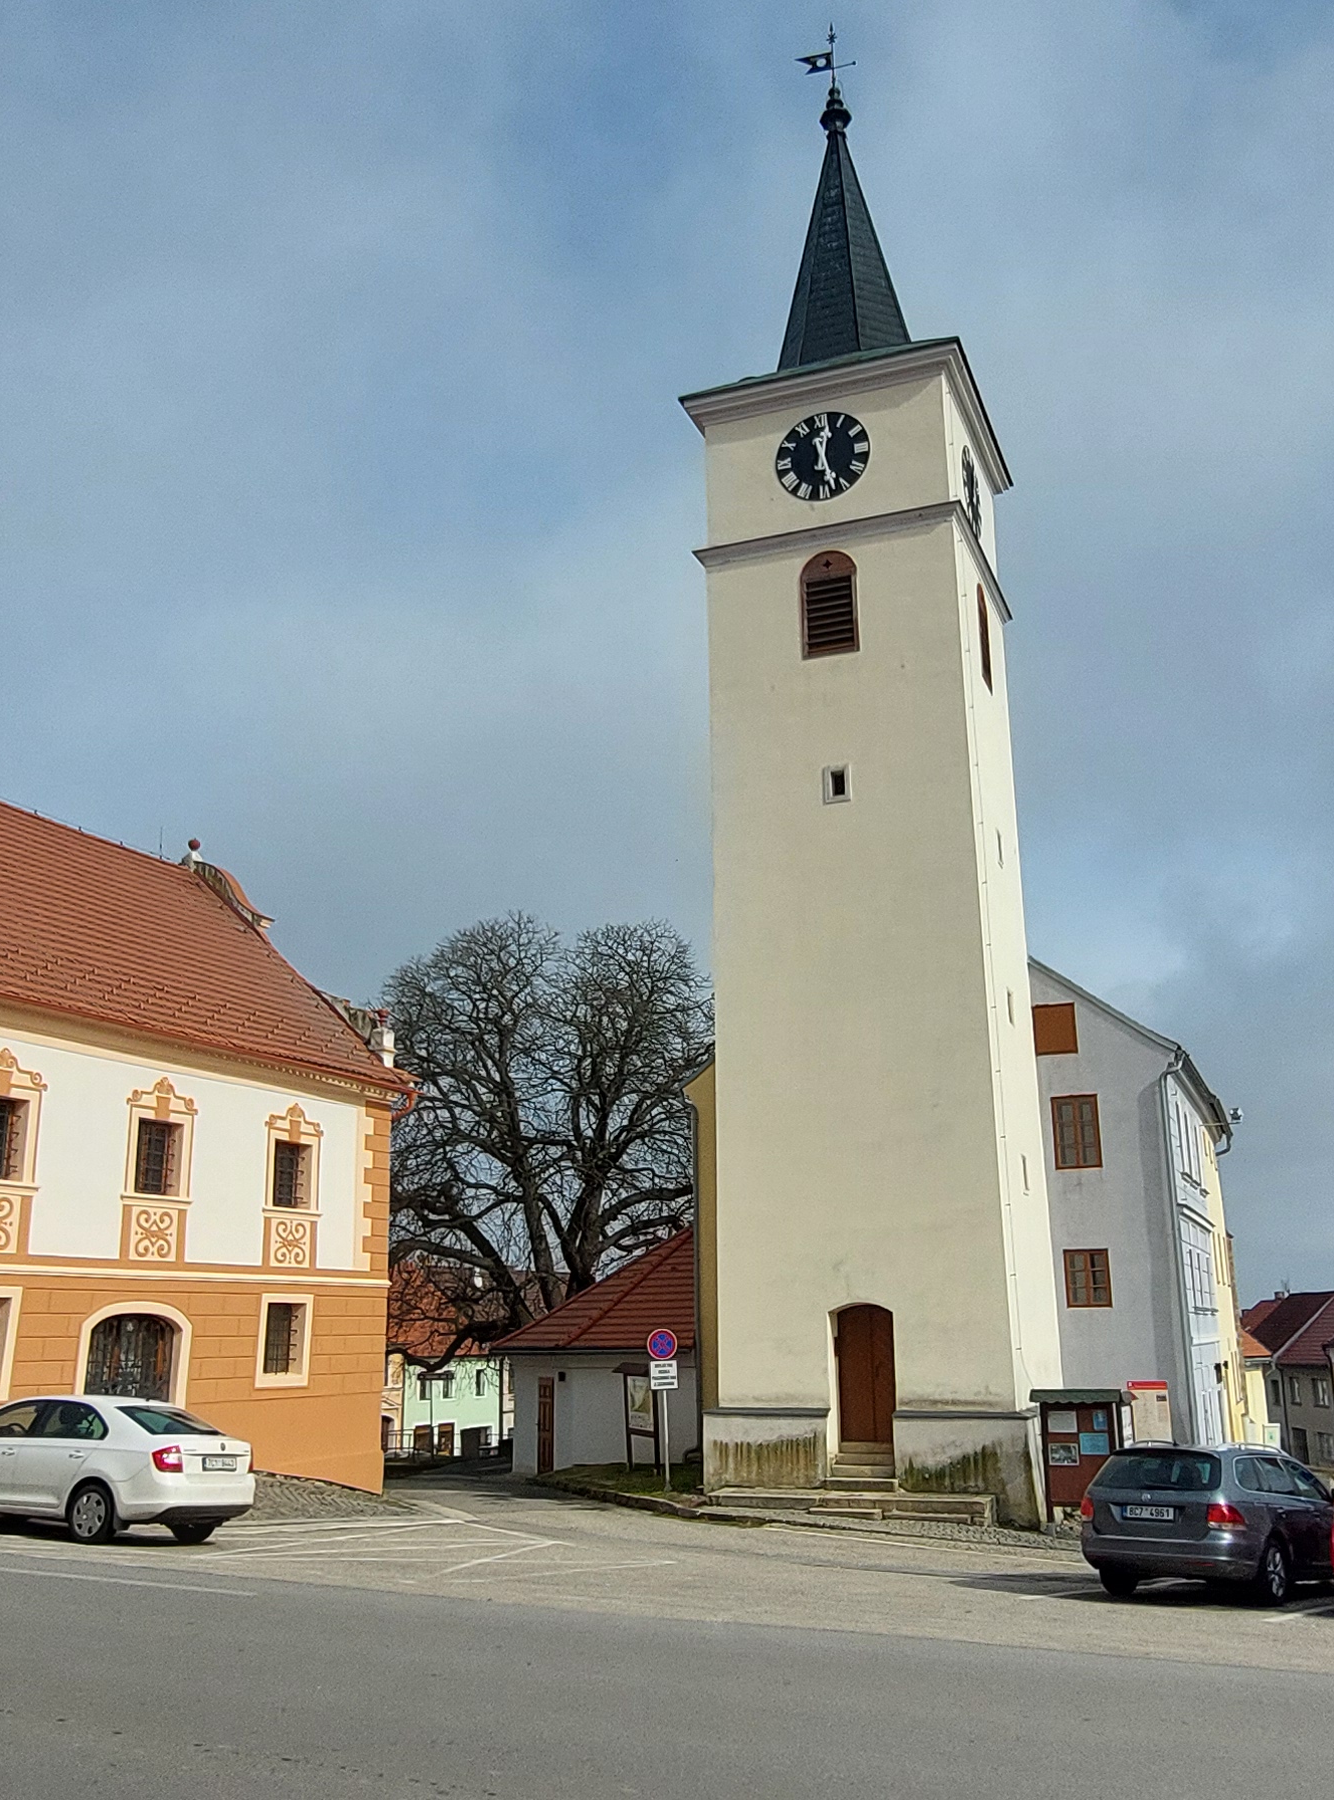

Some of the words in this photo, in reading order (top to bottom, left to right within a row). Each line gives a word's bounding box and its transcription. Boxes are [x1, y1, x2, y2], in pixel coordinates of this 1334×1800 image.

[795, 422, 810, 438] XI
[848, 424, 863, 438] II
[781, 440, 797, 451] X
[853, 441, 868, 454] III
[777, 457, 792, 470] IX
[849, 459, 865, 475] IV
[781, 471, 800, 491] VIII
[838, 477, 850, 491] V
[797, 482, 812, 499] VII
[819, 484, 830, 499] VI
